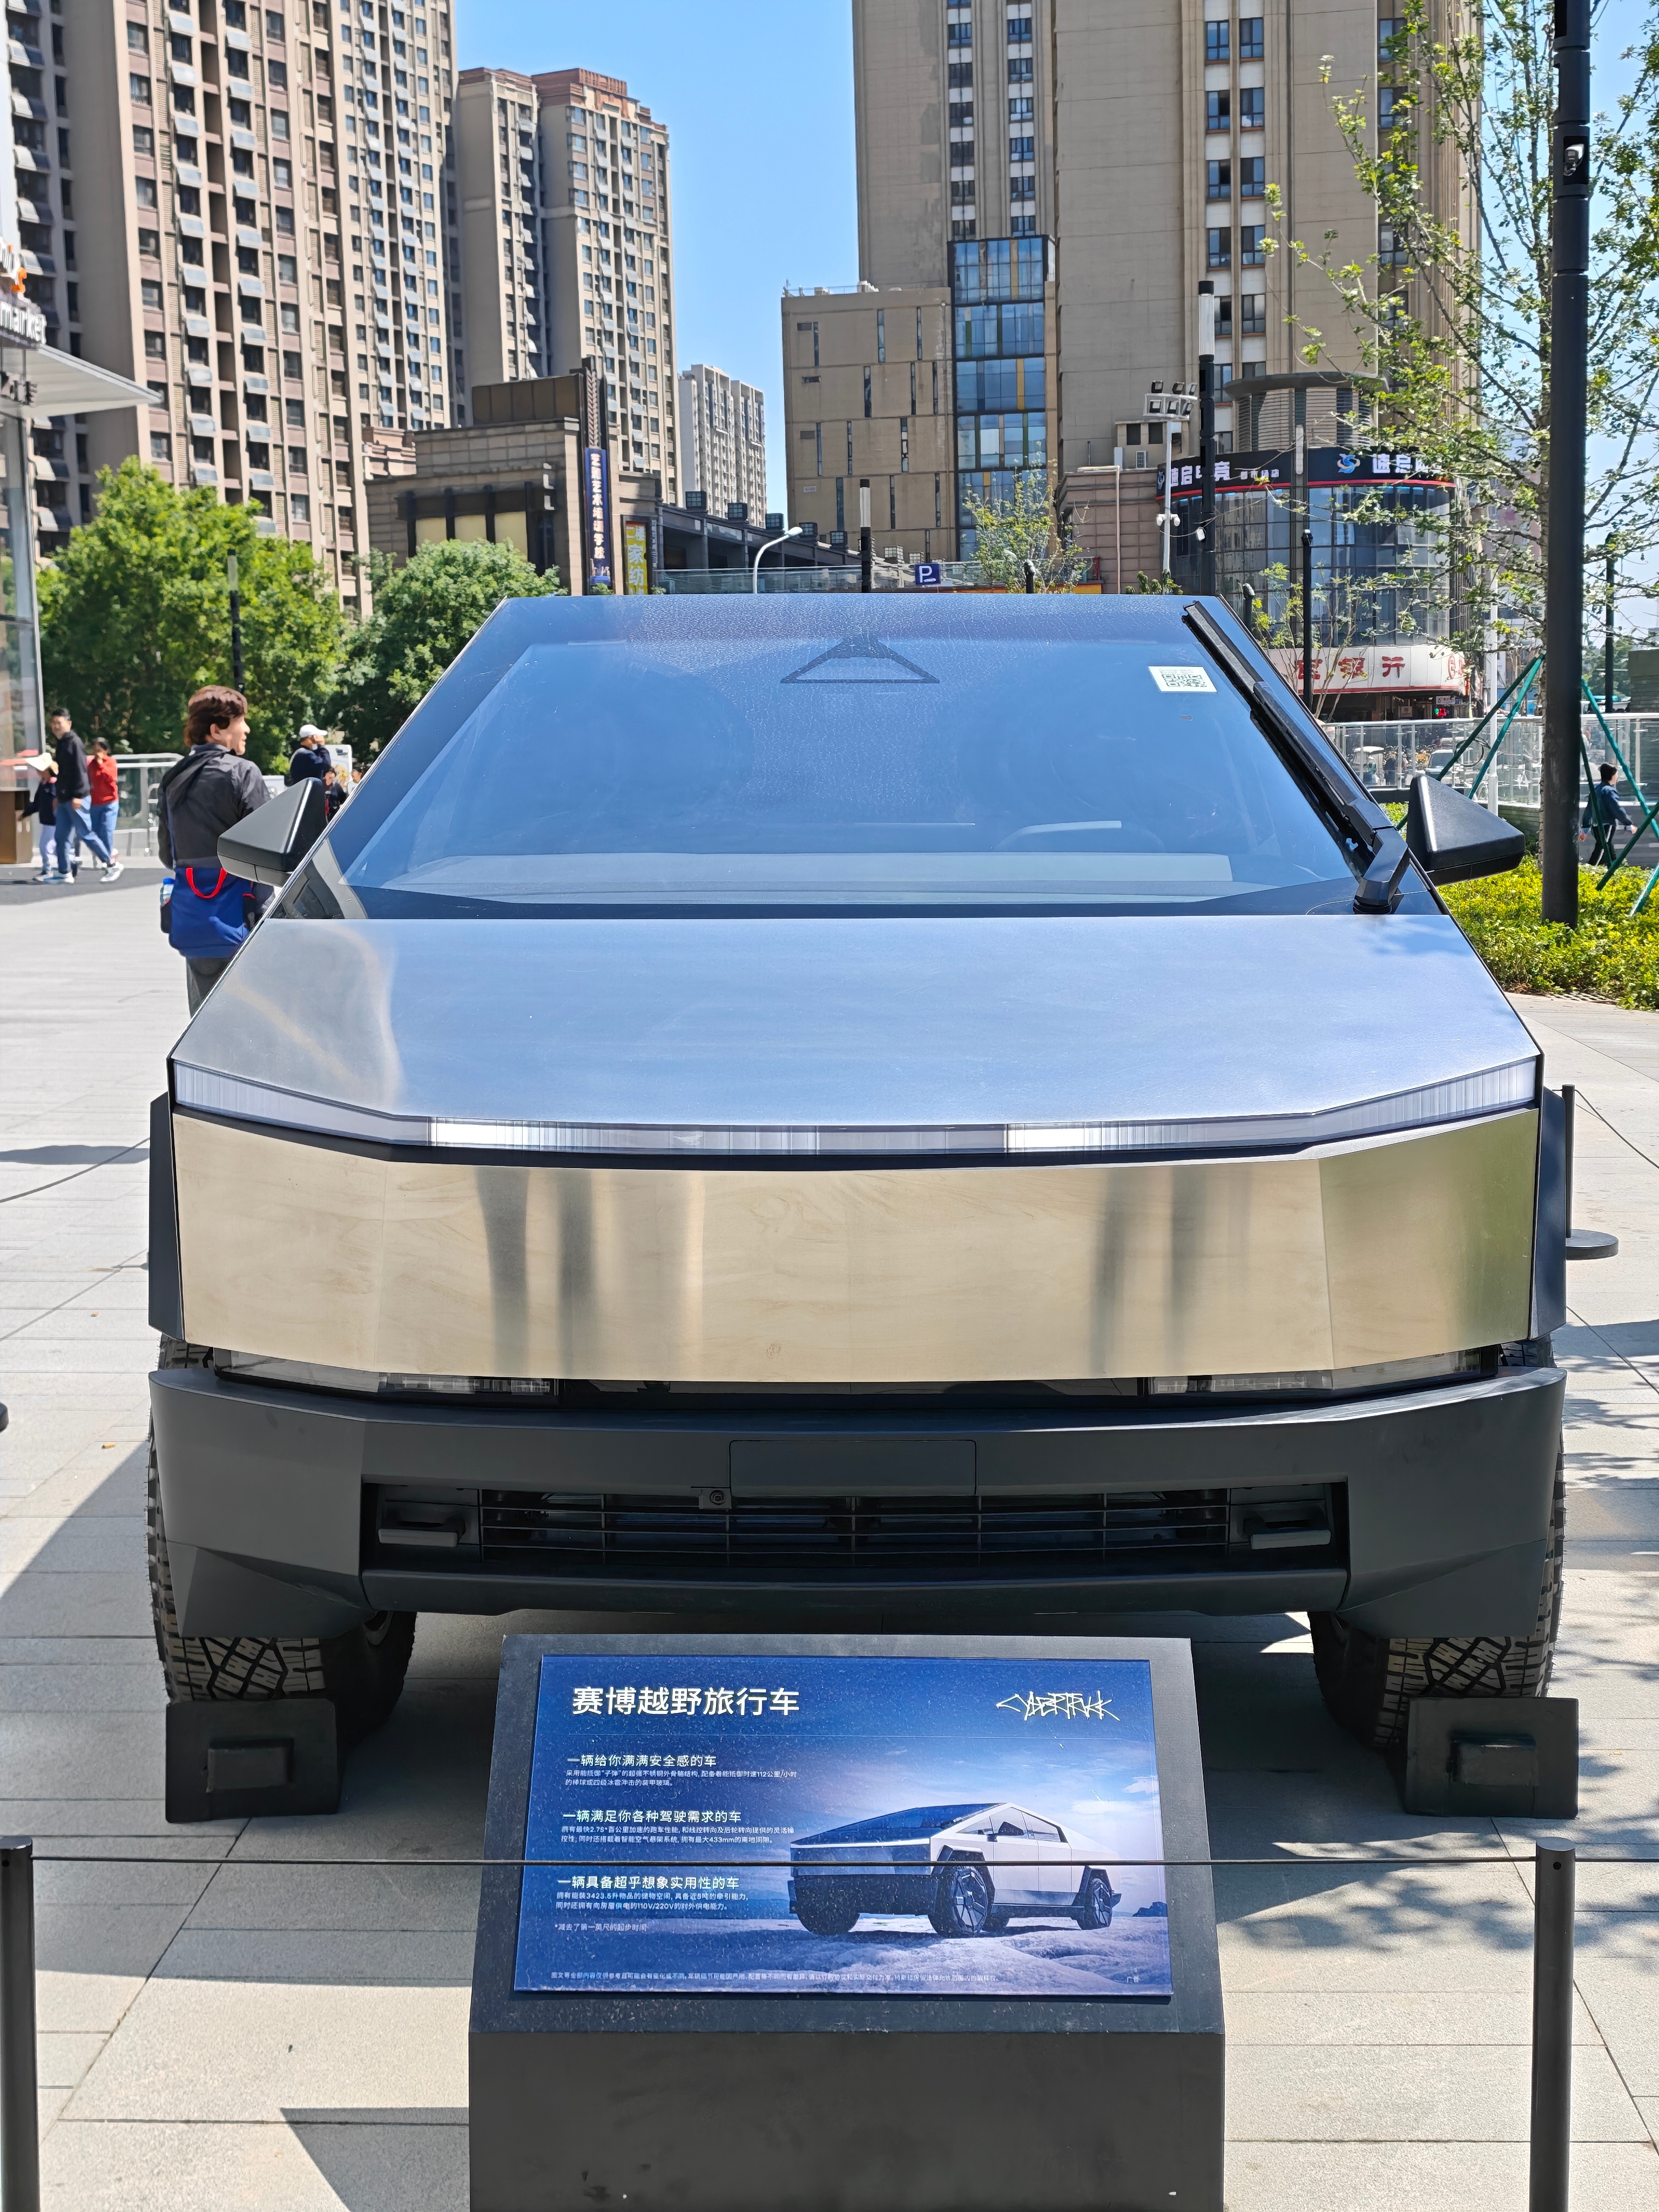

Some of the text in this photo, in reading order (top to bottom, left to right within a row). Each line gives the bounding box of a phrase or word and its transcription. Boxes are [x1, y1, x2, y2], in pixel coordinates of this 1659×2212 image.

[919, 565, 933, 583] P
[572, 1686, 799, 1716] 赛博越野旅行车
[567, 1754, 717, 1766] 一辆给你满满安全感的车
[563, 1810, 741, 1823] 一辆满足你各种驾驶需求的车
[557, 1876, 739, 1889] 一辆具备超乎想象实用性的车
